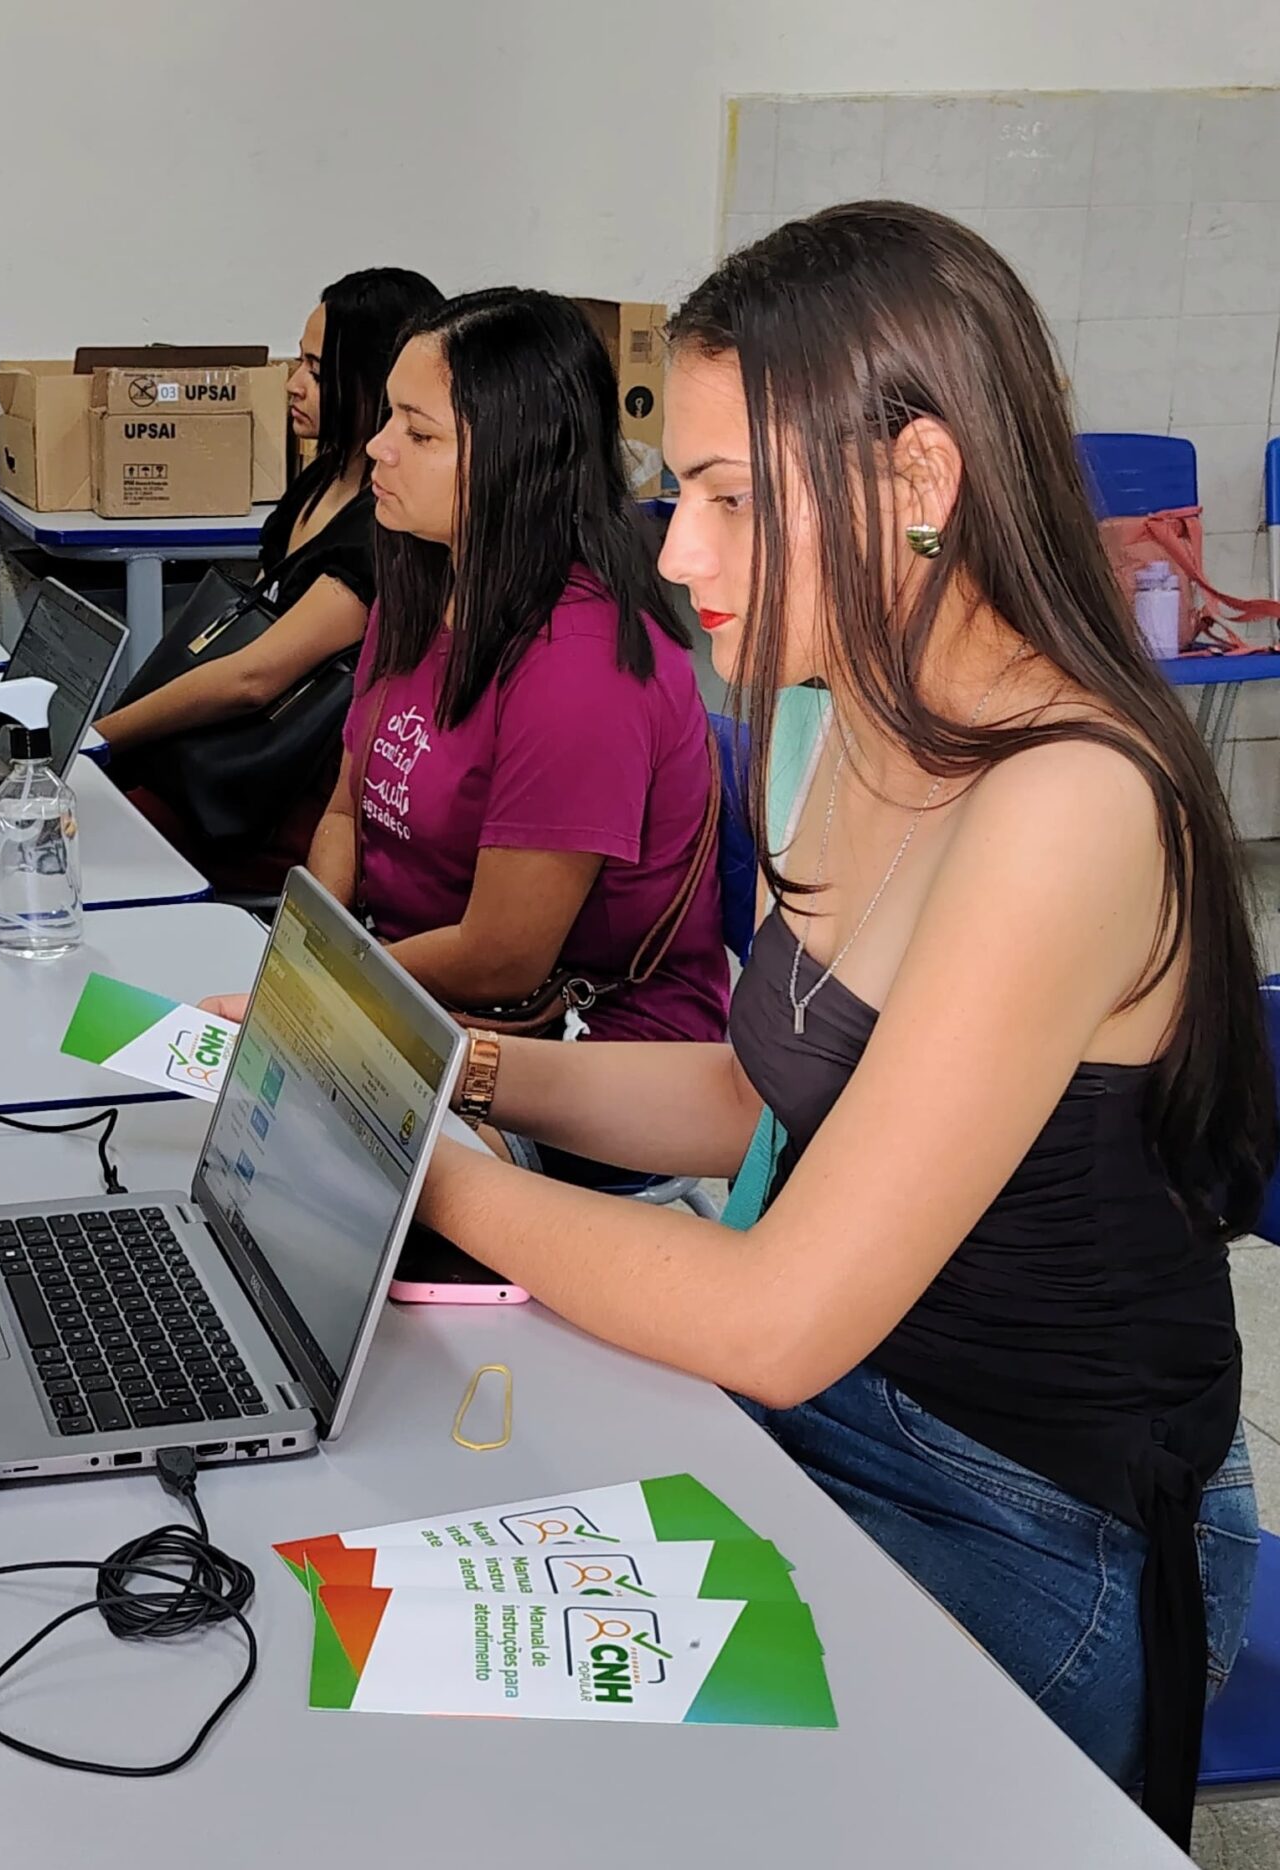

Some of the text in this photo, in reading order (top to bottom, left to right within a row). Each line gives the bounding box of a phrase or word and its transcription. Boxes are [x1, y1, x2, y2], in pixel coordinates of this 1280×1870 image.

[160, 385, 236, 401] 03 UPSAI
[124, 423, 176, 439] UPSAI
[195, 1024, 228, 1067] CNH
[445, 1525, 471, 1547] inst
[459, 1557, 483, 1592] atend
[484, 1557, 505, 1593] instru
[474, 1603, 494, 1682] atendimento
[496, 1604, 522, 1698] instruções para
[529, 1605, 551, 1667] Manual de
[578, 1660, 593, 1702] POPULAR
[590, 1644, 634, 1703] CNH
